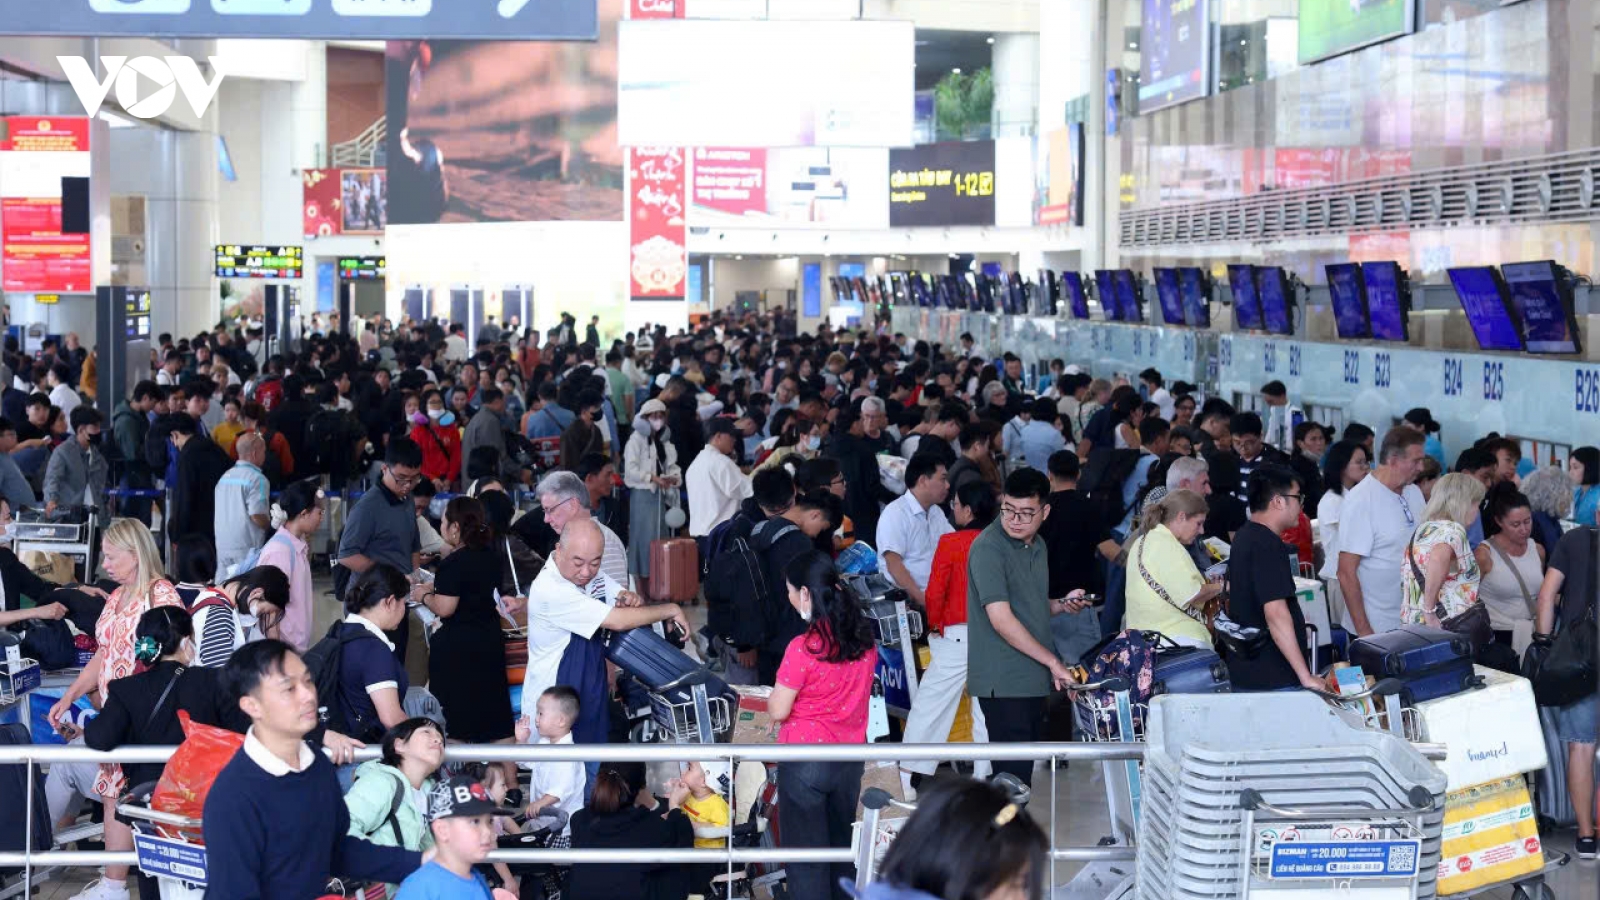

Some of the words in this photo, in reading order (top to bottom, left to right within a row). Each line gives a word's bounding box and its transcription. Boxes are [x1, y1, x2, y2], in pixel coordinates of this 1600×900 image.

[954, 173, 978, 196] 1-12
[1345, 350, 1359, 384] B22
[1375, 353, 1390, 388] B23
[1445, 358, 1462, 396] B24
[1484, 361, 1504, 401] B25
[1575, 369, 1600, 413] B26
[881, 664, 902, 690] ACV
[1319, 847, 1347, 859] 20.000
